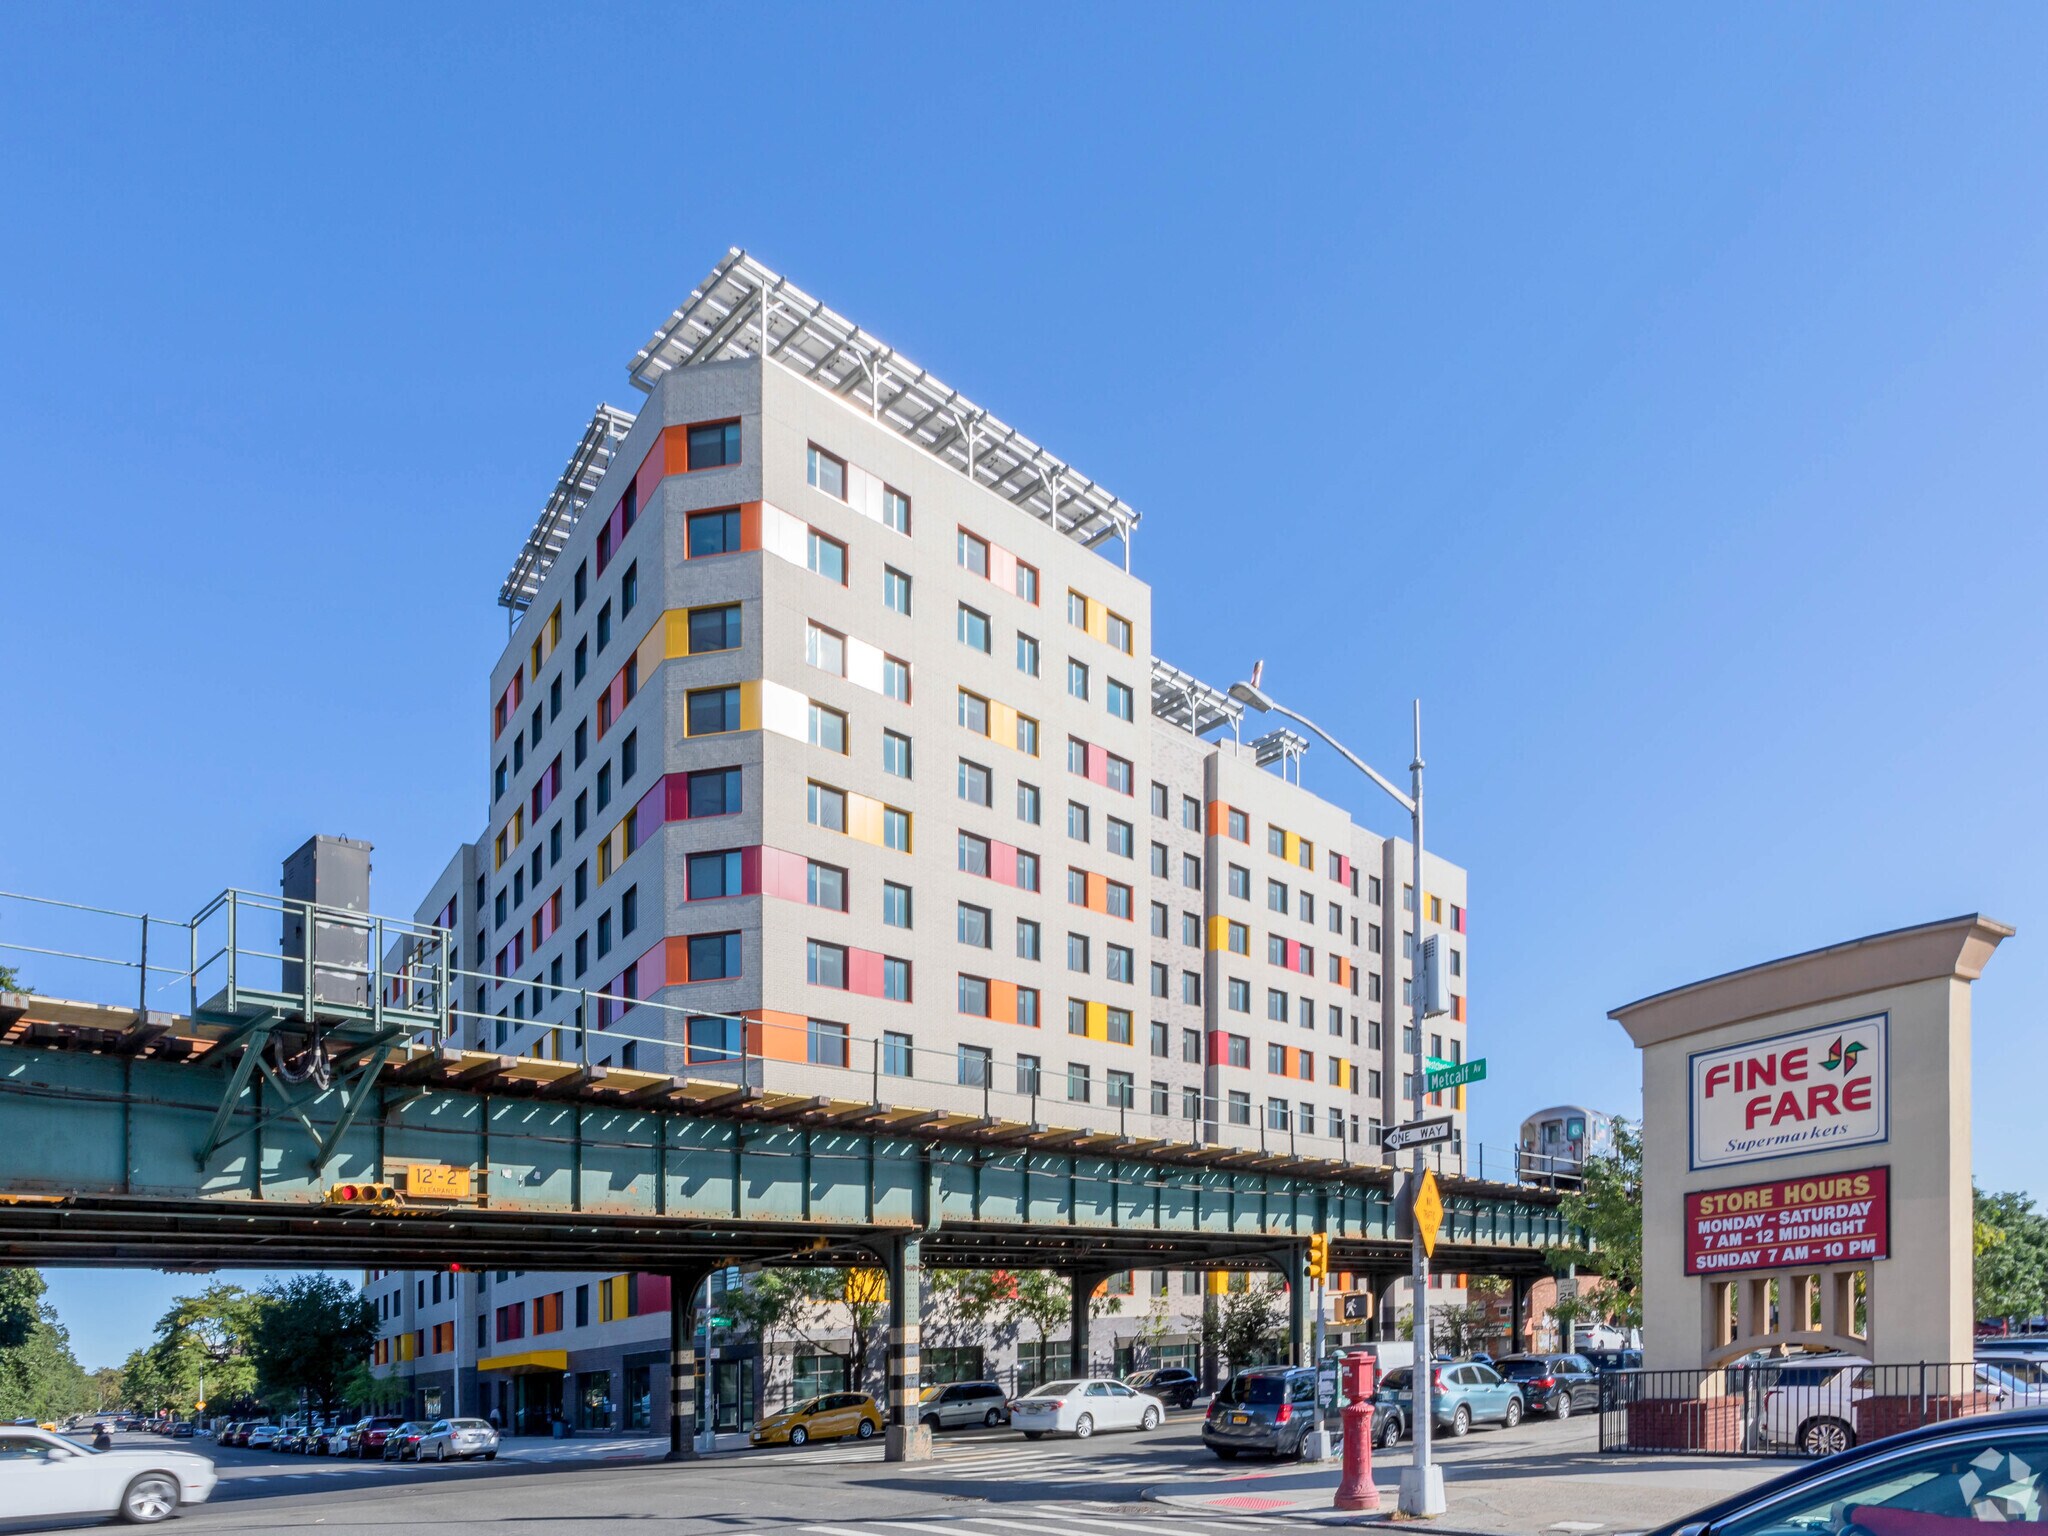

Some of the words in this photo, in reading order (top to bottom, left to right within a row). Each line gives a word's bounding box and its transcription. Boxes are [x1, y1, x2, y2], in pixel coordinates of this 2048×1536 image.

[1431, 1065, 1469, 1090] Metcalf
[1704, 1046, 1809, 1099] FINE
[1745, 1075, 1872, 1131] FARE
[1391, 1131, 1411, 1145] ONE
[1420, 1124, 1443, 1139] WAY
[1571, 1124, 1580, 1135] 6
[1724, 1123, 1849, 1153] Supermarkets
[419, 1185, 459, 1195] CLEARANCE
[1700, 1187, 1774, 1215] STORE
[1784, 1174, 1871, 1205] HOURS
[1698, 1213, 1766, 1234] MONDAY
[1778, 1201, 1873, 1225] SATURDAY
[1703, 1235, 1714, 1250] 7
[1716, 1233, 1743, 1249] AM
[1755, 1229, 1774, 1245] 12
[1778, 1218, 1867, 1242] MIDNIGHT
[1696, 1249, 1761, 1270] SUNDAY
[1767, 1248, 1778, 1263] 7
[1781, 1246, 1810, 1262] AM
[1823, 1241, 1844, 1258] 10
[1848, 1238, 1877, 1256] PM
[1559, 1291, 1575, 1302] 25
